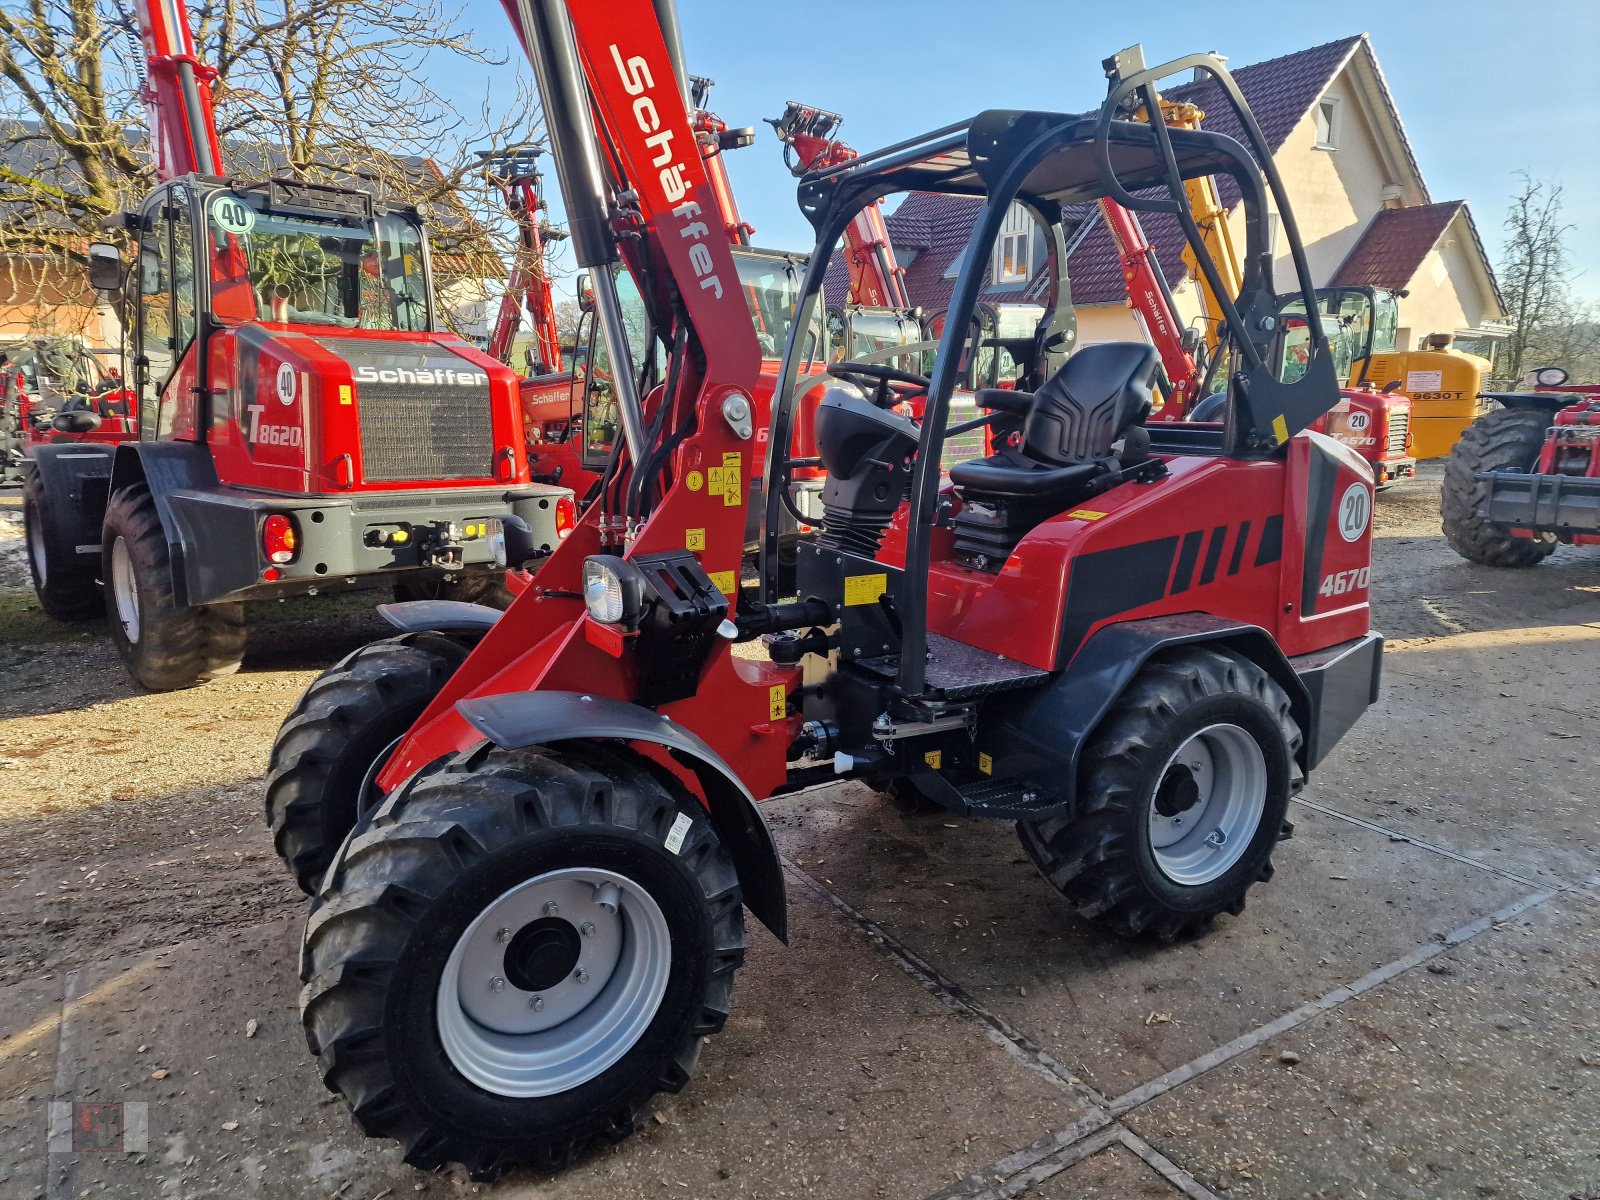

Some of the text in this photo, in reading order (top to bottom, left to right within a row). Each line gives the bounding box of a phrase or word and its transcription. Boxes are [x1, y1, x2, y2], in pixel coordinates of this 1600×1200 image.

[609, 44, 723, 300] Schäffer
[221, 203, 247, 227] 40
[1144, 290, 1168, 336] Schäffer
[281, 371, 293, 397] 40
[355, 366, 489, 385] Schäffer
[531, 391, 571, 405] Schäffer
[1413, 392, 1463, 400] 9630 T
[247, 405, 302, 446] T8620
[1351, 415, 1365, 428] 20
[1344, 494, 1365, 531] 20
[1319, 566, 1370, 597] 4670
